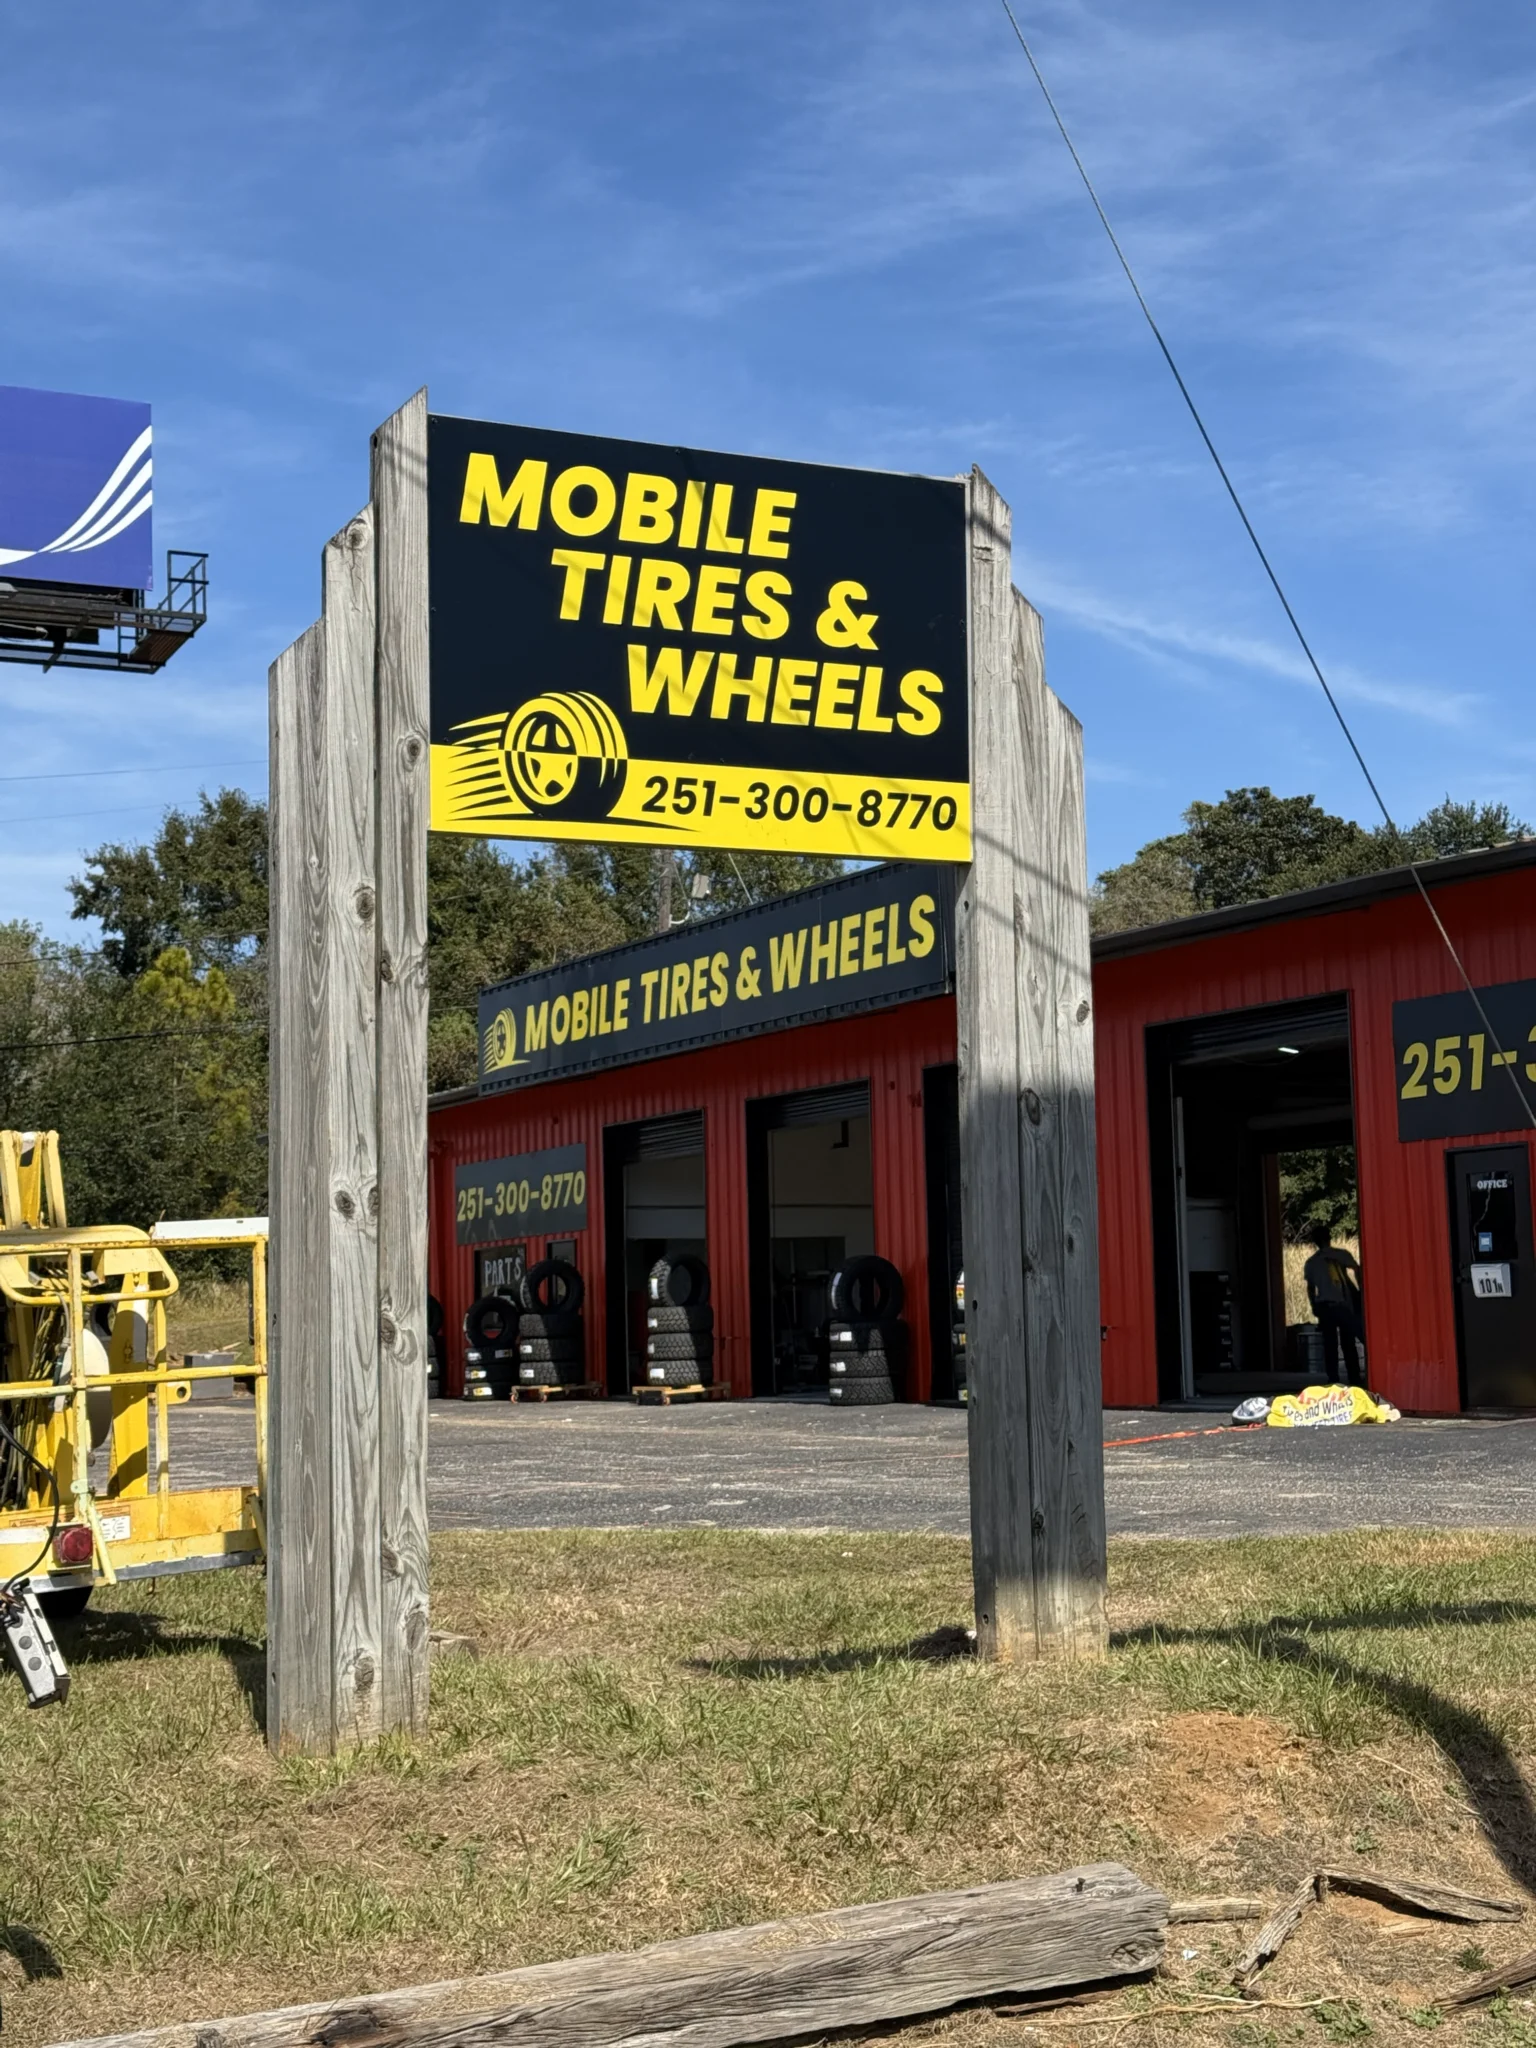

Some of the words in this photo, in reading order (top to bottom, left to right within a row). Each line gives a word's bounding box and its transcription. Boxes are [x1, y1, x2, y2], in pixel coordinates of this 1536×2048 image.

[459, 452, 798, 559] MOBILE
[551, 548, 792, 640] TIRES
[816, 580, 879, 650] &
[627, 644, 944, 736] WHEELS
[641, 775, 957, 832] 251-300-8770
[524, 978, 630, 1053] MOBILE
[640, 950, 729, 1024] TIRES
[735, 945, 762, 1000] &
[768, 894, 936, 993] WHEELS
[457, 1170, 586, 1222] 251-300-8770
[1477, 1179, 1508, 1190] OFFICE
[484, 1257, 522, 1287] PARTS
[1304, 1403, 1320, 1419] and
